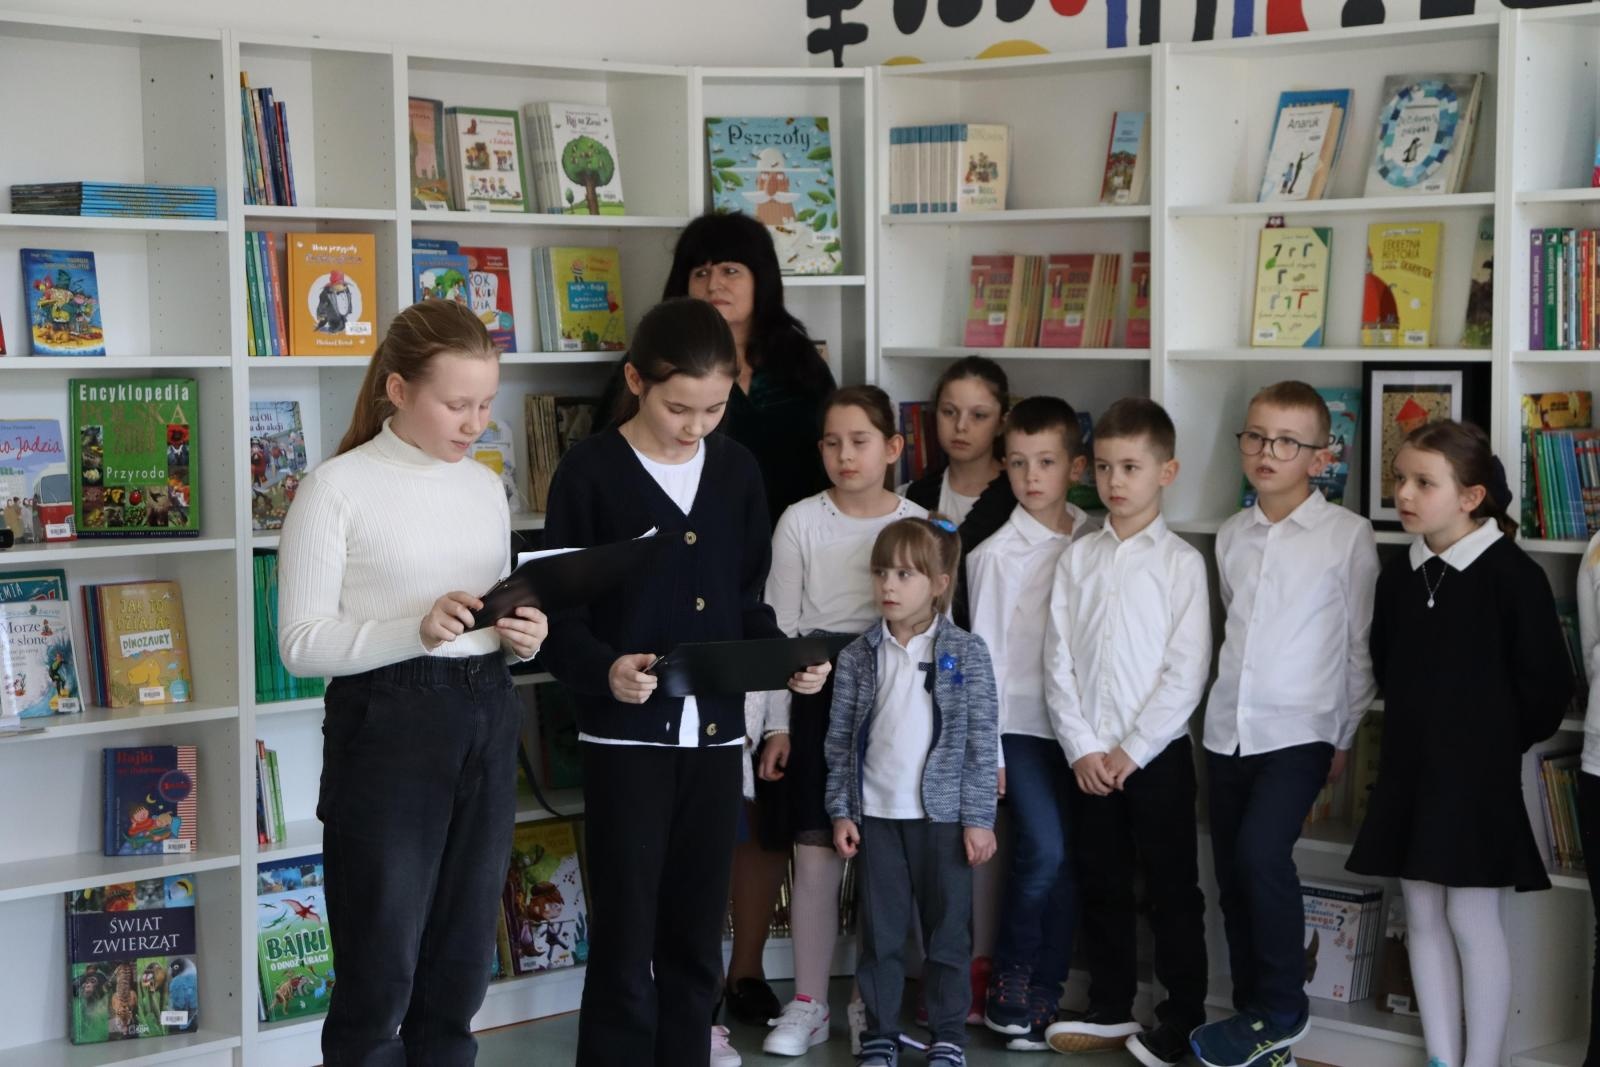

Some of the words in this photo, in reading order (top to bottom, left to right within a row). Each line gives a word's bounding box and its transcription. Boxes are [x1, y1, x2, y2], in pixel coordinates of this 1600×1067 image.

[728, 124, 811, 152] Pszczoły
[79, 384, 190, 403] Encyklopedia
[106, 466, 166, 482] Przyroda
[122, 633, 171, 651] DINOZAURY
[109, 916, 163, 935] ŚWIAT
[92, 933, 181, 954] ZWIERZĄT
[265, 927, 329, 961] BAJKI
